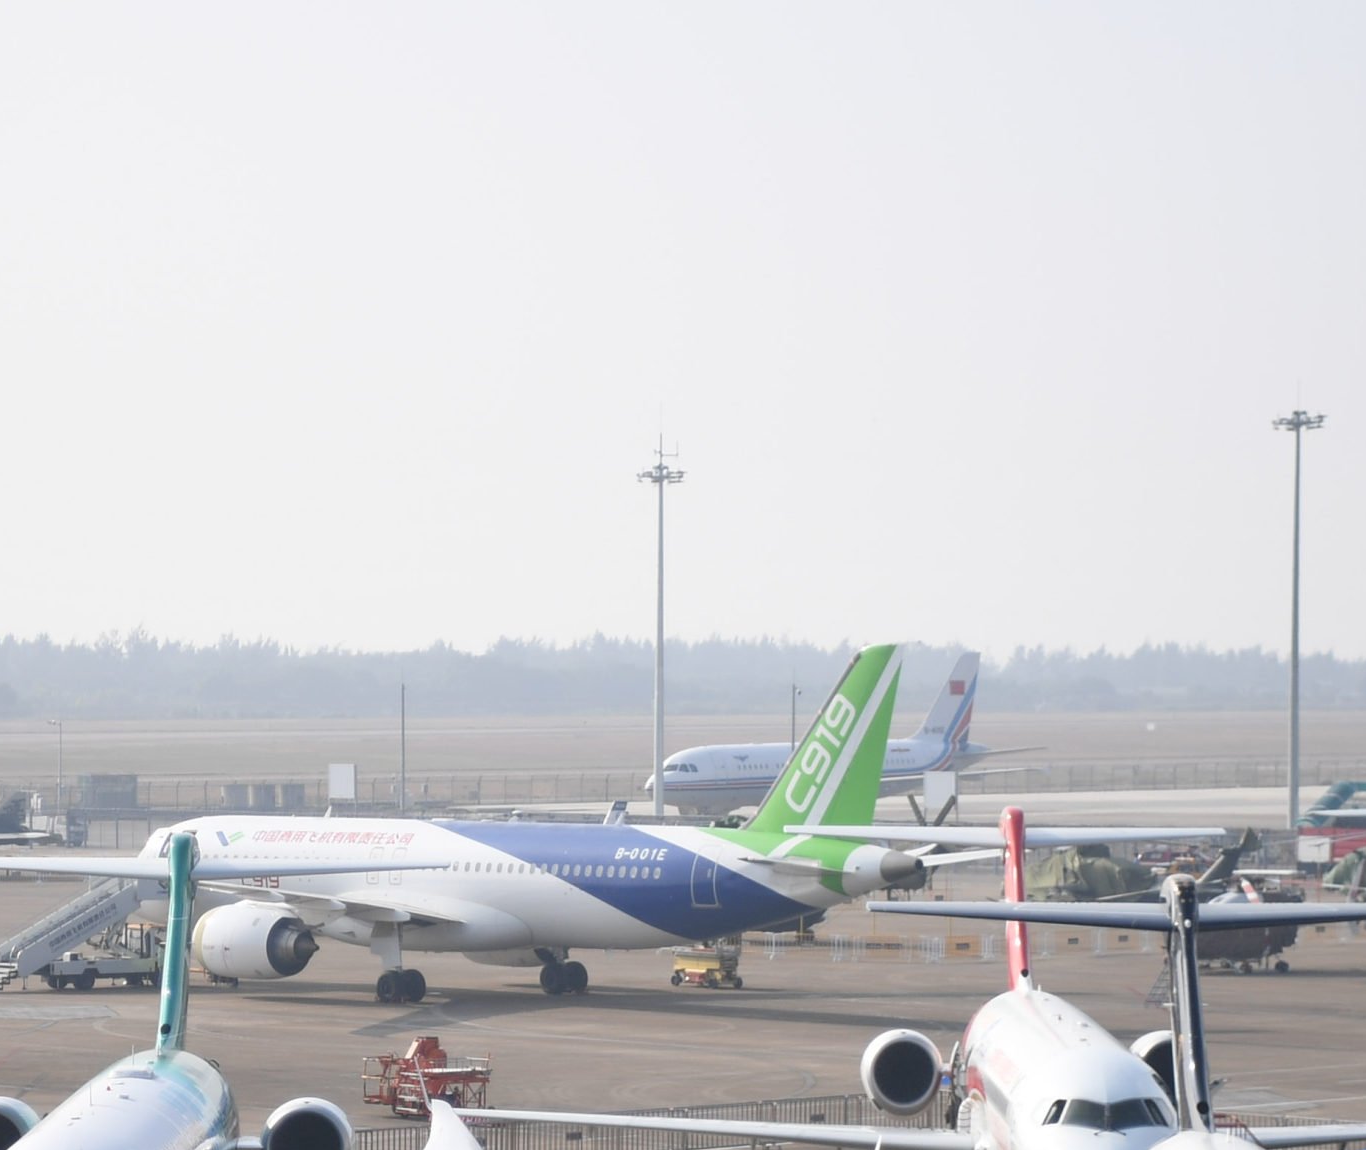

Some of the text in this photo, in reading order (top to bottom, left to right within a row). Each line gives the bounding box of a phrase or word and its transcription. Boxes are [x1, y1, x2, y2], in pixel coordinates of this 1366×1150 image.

[786, 693, 856, 813] C919
[252, 830, 415, 846] 中国商用飞机有限责任公司
[615, 847, 668, 861] B-001E
